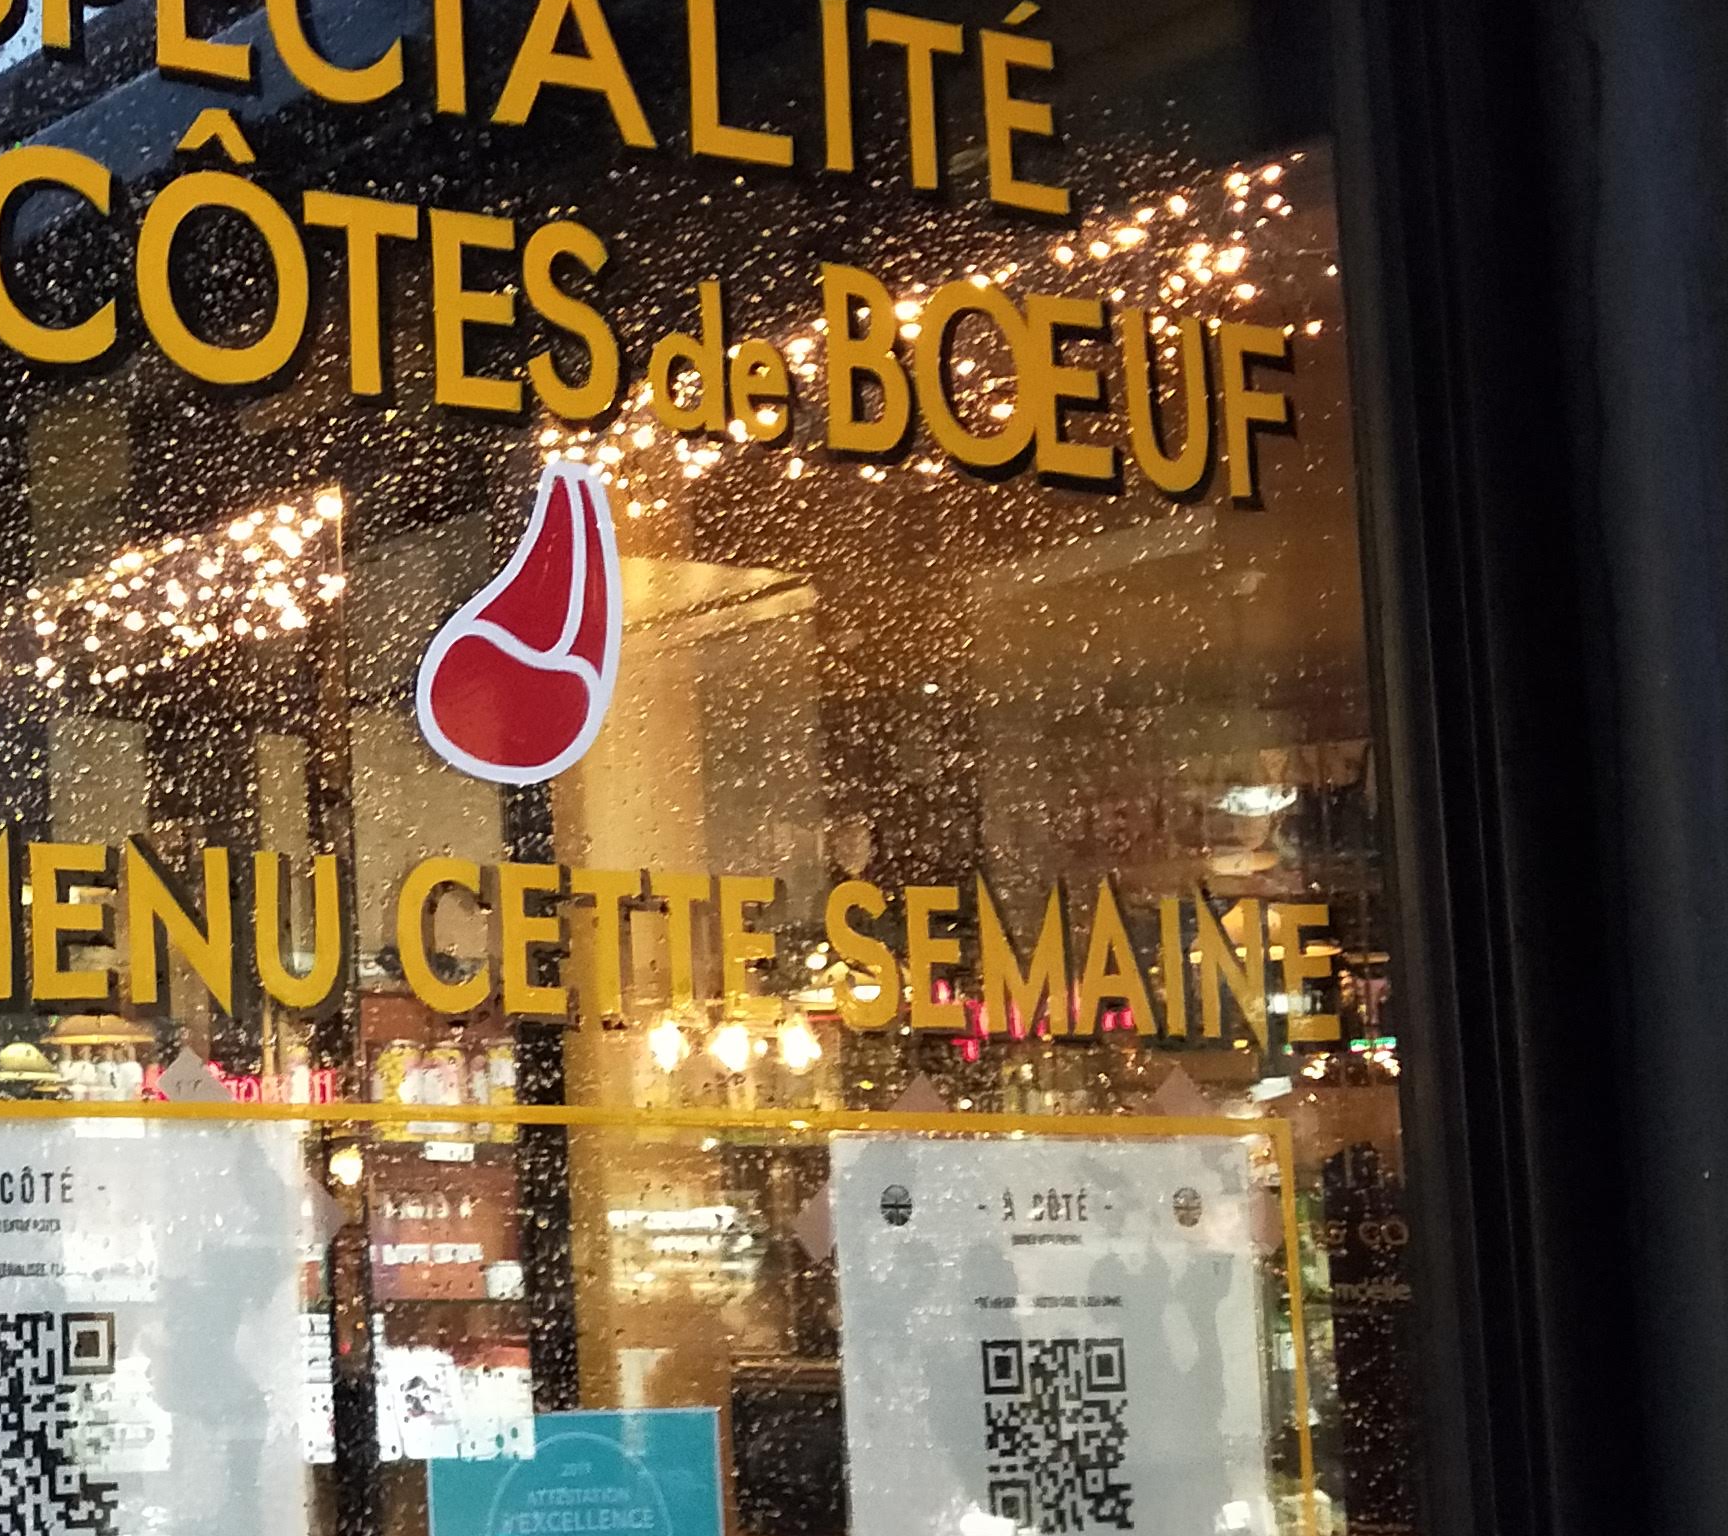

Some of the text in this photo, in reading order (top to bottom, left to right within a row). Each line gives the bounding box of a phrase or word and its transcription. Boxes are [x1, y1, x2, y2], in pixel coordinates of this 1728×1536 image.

[646, 280, 792, 442] de
[396, 860, 780, 1032] CETTE
[824, 872, 1342, 1052] SEMAINE
[0, 1166, 75, 1205] CÔTÉ
